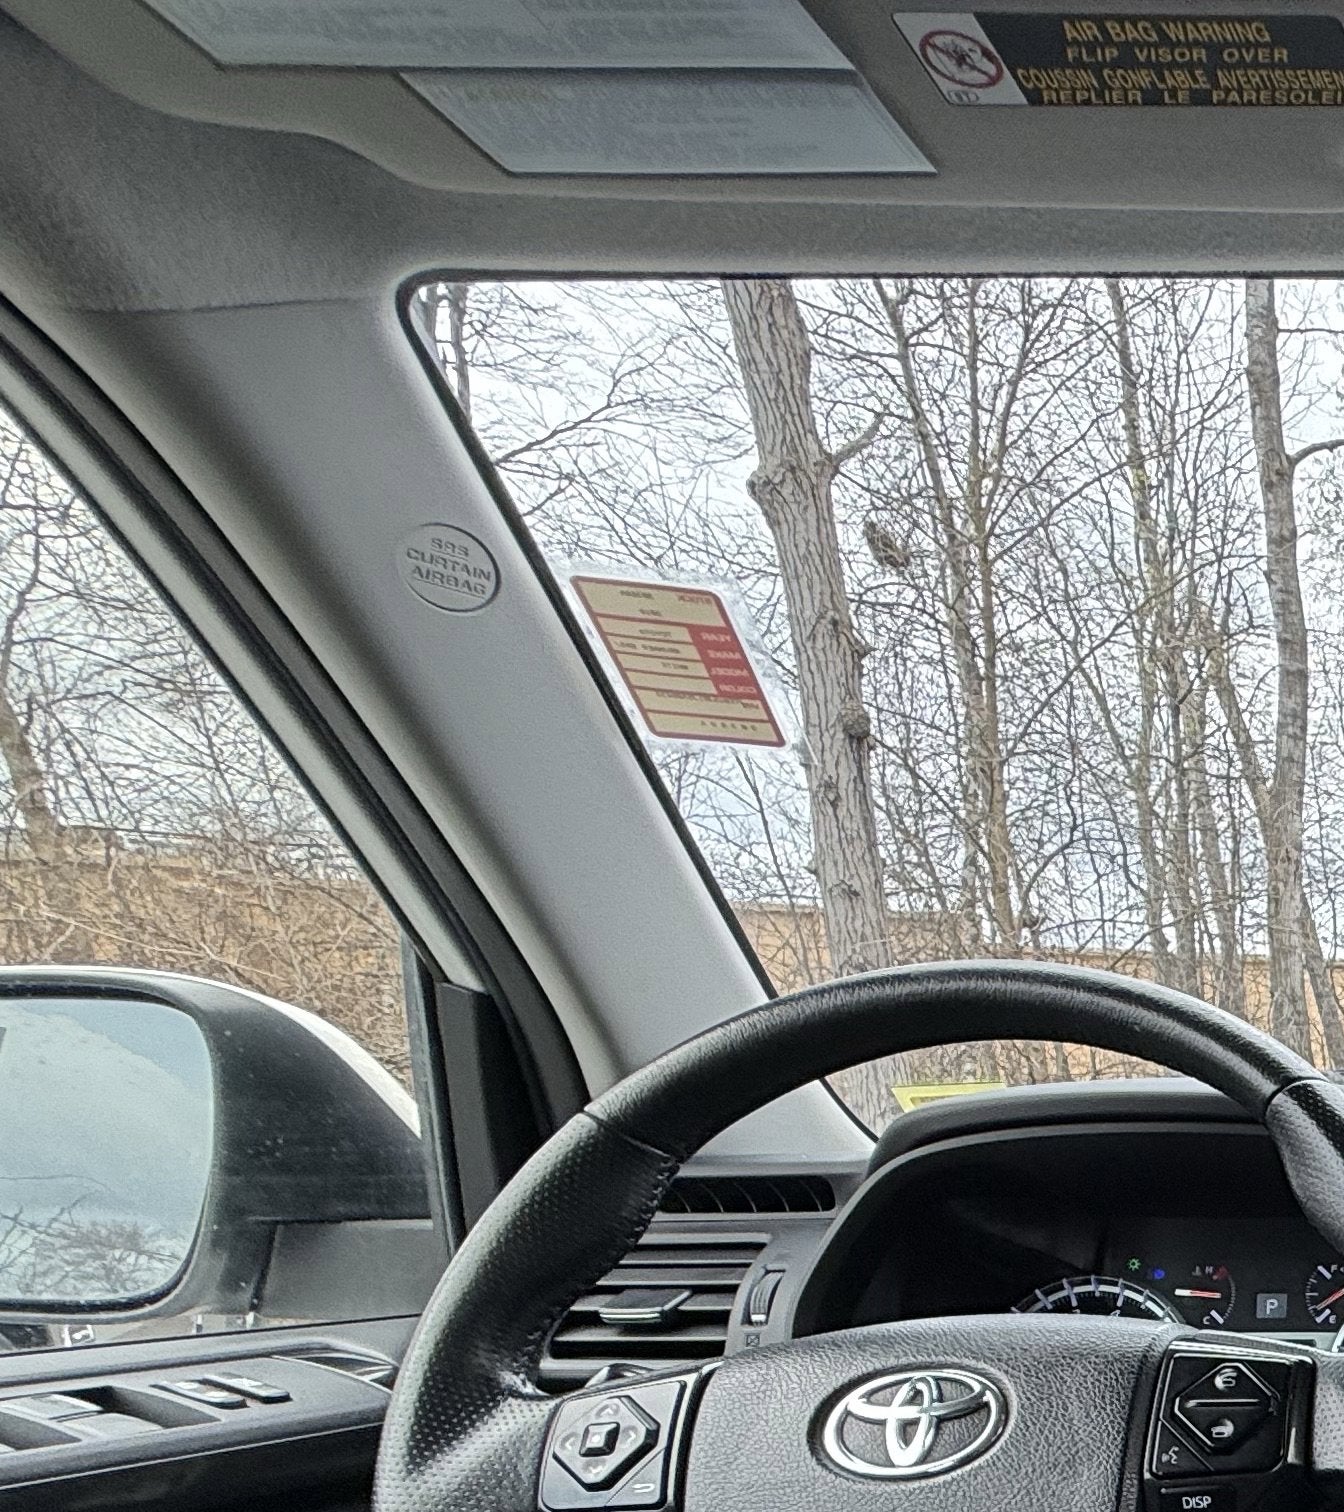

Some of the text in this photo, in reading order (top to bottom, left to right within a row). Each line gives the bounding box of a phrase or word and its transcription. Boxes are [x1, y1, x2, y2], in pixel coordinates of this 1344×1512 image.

[1063, 21, 1271, 43] AIR BAG WARNING
[1066, 47, 1289, 63] FLIP VISOR OVER
[1017, 68, 1100, 89] COUSSIN
[1102, 68, 1210, 89] GONFLABLE
[1042, 90, 1143, 104] REPLIER
[1164, 90, 1190, 104] LE
[406, 547, 491, 581] CURTAIN
[411, 565, 487, 596] AIRBAG
[1264, 1299, 1280, 1315] P
[1182, 1496, 1212, 1510] DISP
